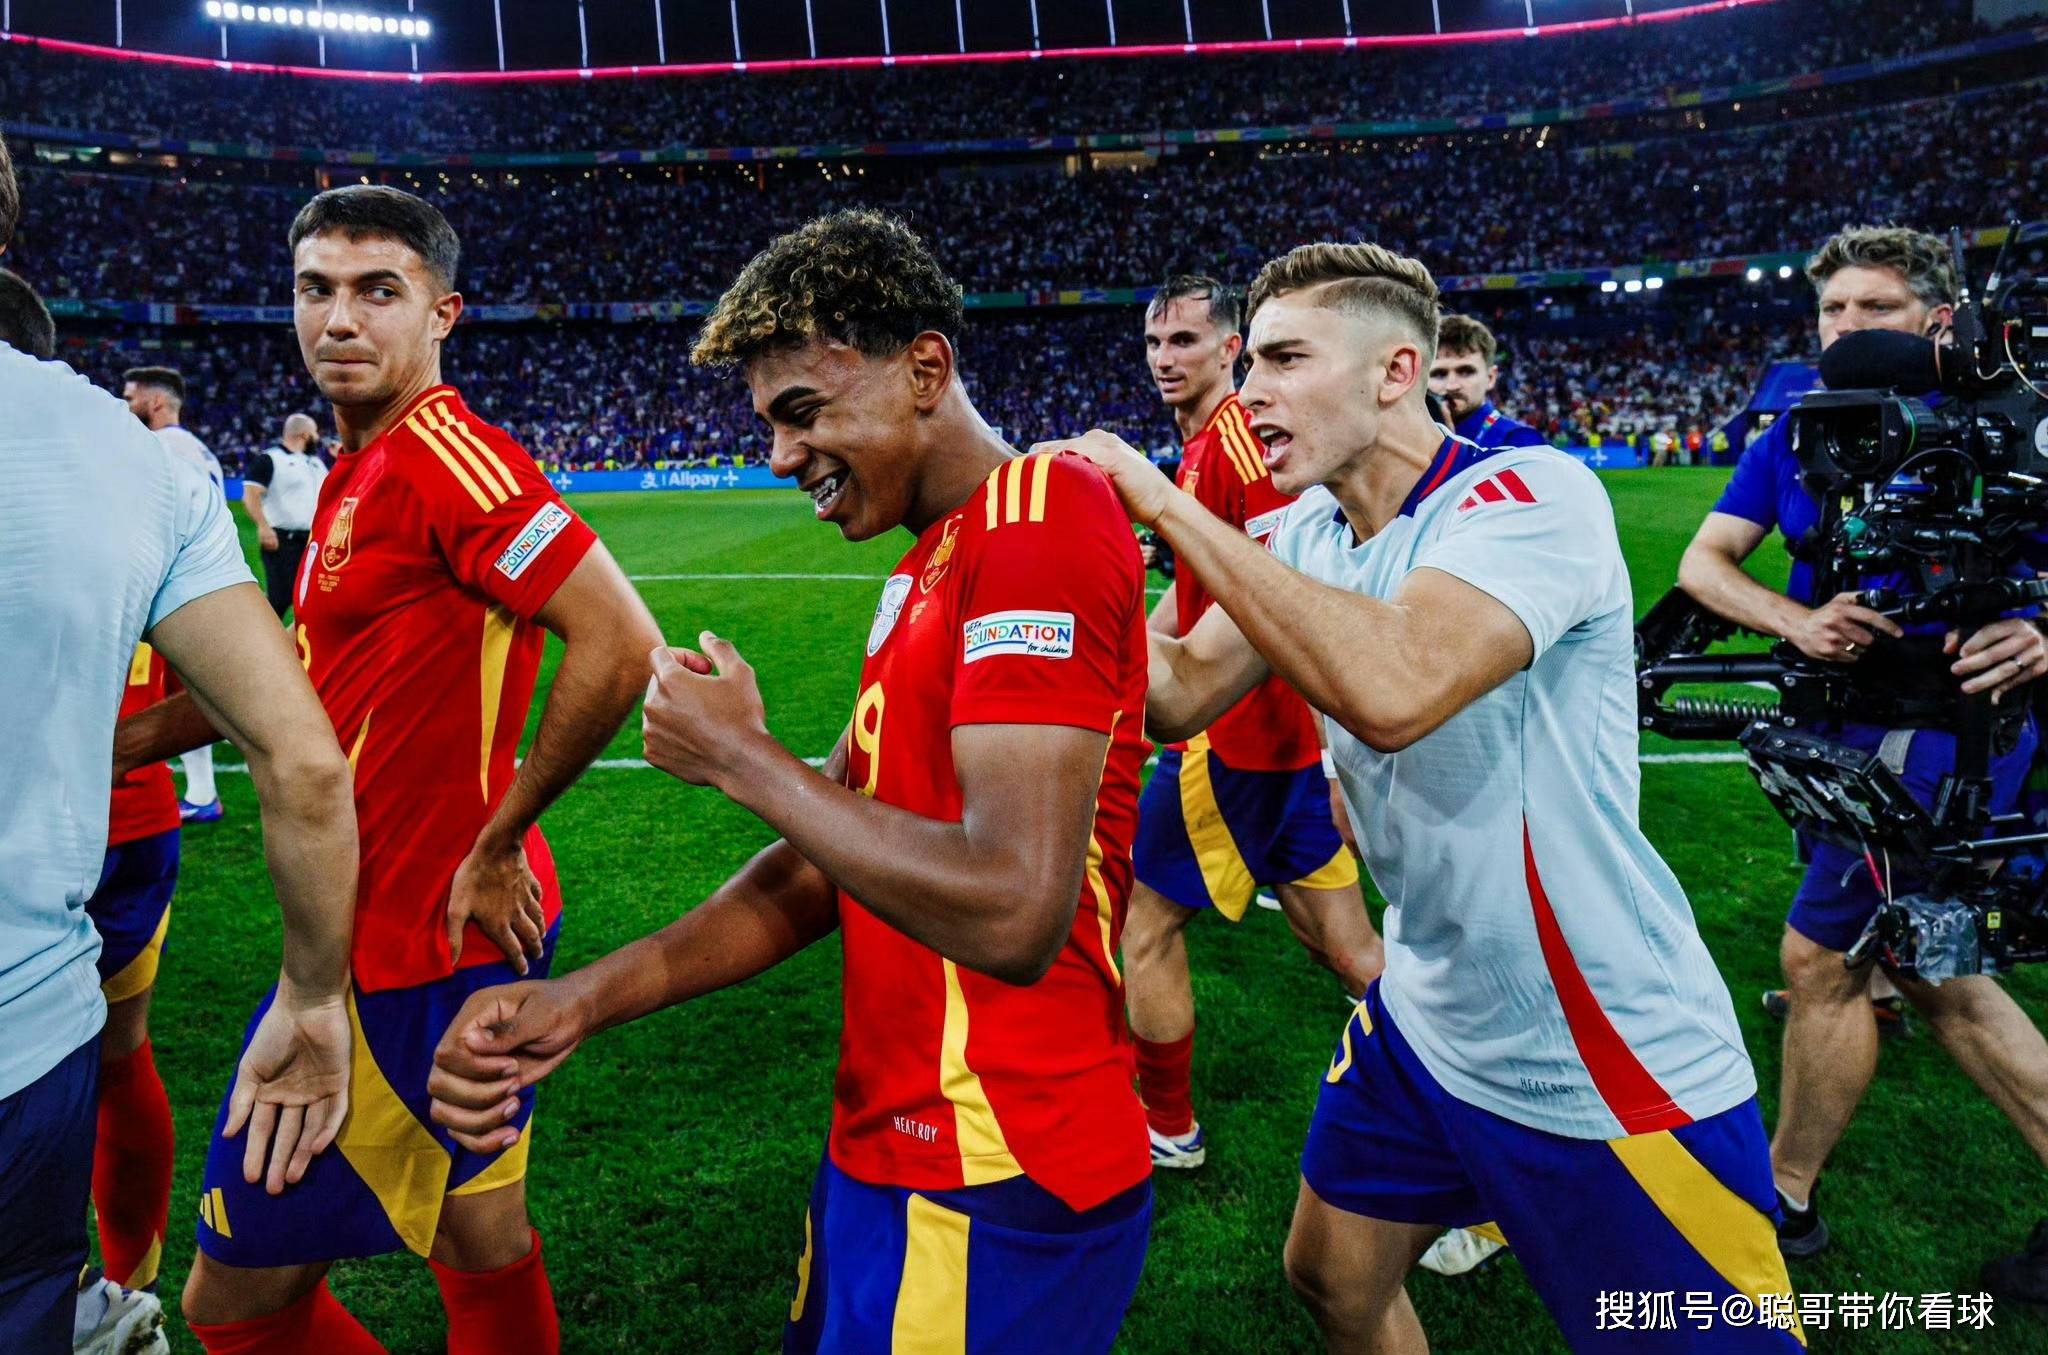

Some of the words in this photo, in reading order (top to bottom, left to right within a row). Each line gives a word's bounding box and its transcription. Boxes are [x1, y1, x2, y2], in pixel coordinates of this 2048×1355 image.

[965, 620, 982, 634] UEFA
[1027, 642, 1039, 653] for
[1040, 642, 1069, 655] children
